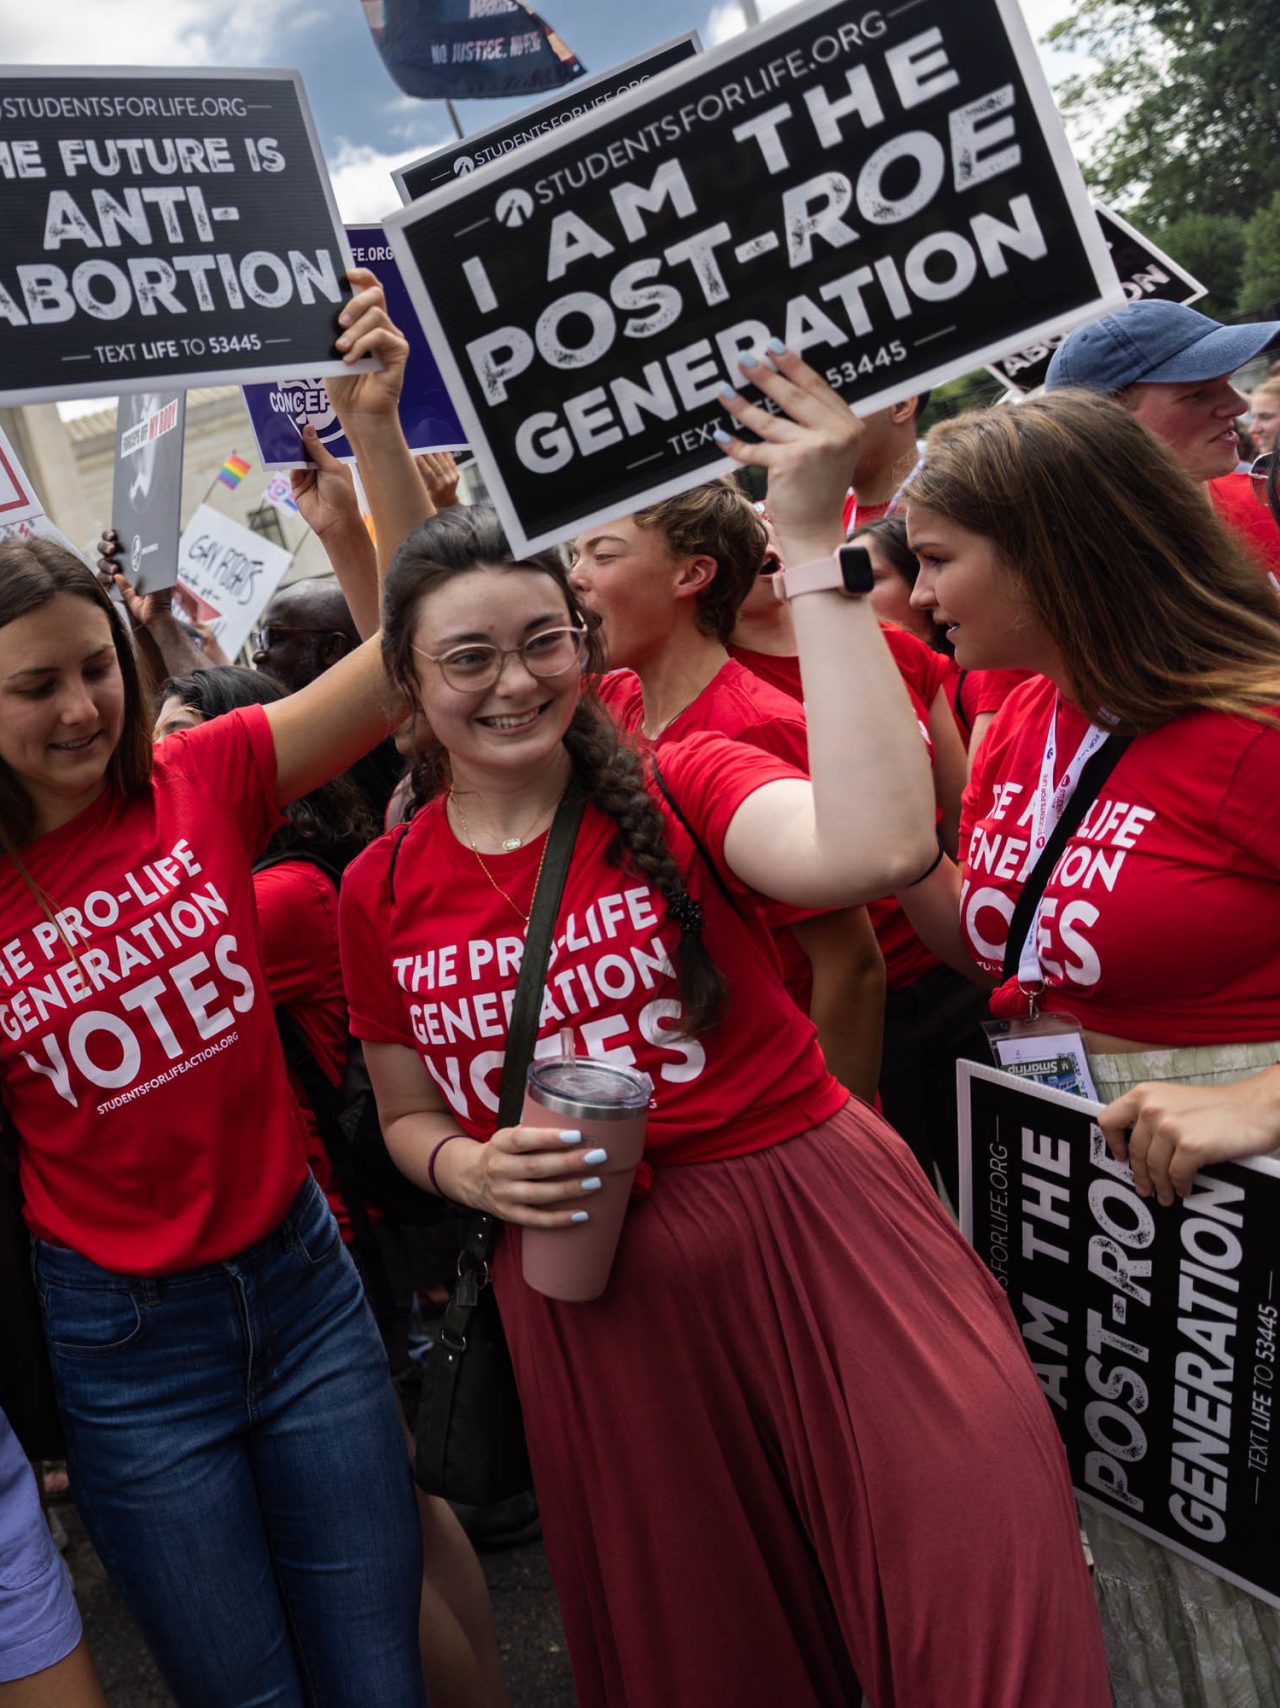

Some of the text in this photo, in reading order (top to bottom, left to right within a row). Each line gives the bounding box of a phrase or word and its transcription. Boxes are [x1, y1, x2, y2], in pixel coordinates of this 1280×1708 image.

[3, 97, 247, 119] STUDENTSFORLIFE.ORG
[58, 137, 235, 178] FUTURE
[245, 136, 286, 173] IS
[534, 9, 887, 208] STUDENTSFORLIFE.ORG
[43, 186, 240, 250] ANTI-
[461, 26, 961, 315] I AM THE
[465, 83, 1022, 407] POST-ROE
[95, 334, 262, 365] TEXT LIFE TO 53445
[515, 194, 1048, 475] GENERATION
[827, 340, 907, 389] 53445
[32, 839, 202, 960] PRO-LIFE
[392, 886, 658, 993] THE PR-LIFE
[19, 934, 255, 1108] VOTES
[97, 1031, 239, 1115] STUDENTSFORLIFEACTION.ORG
[1022, 1126, 1070, 1264] THE
[1021, 1291, 1069, 1411] AM
[1168, 1172, 1246, 1544] GENERATION
[1248, 1303, 1279, 1474] TEXT LIFE TO 53445
